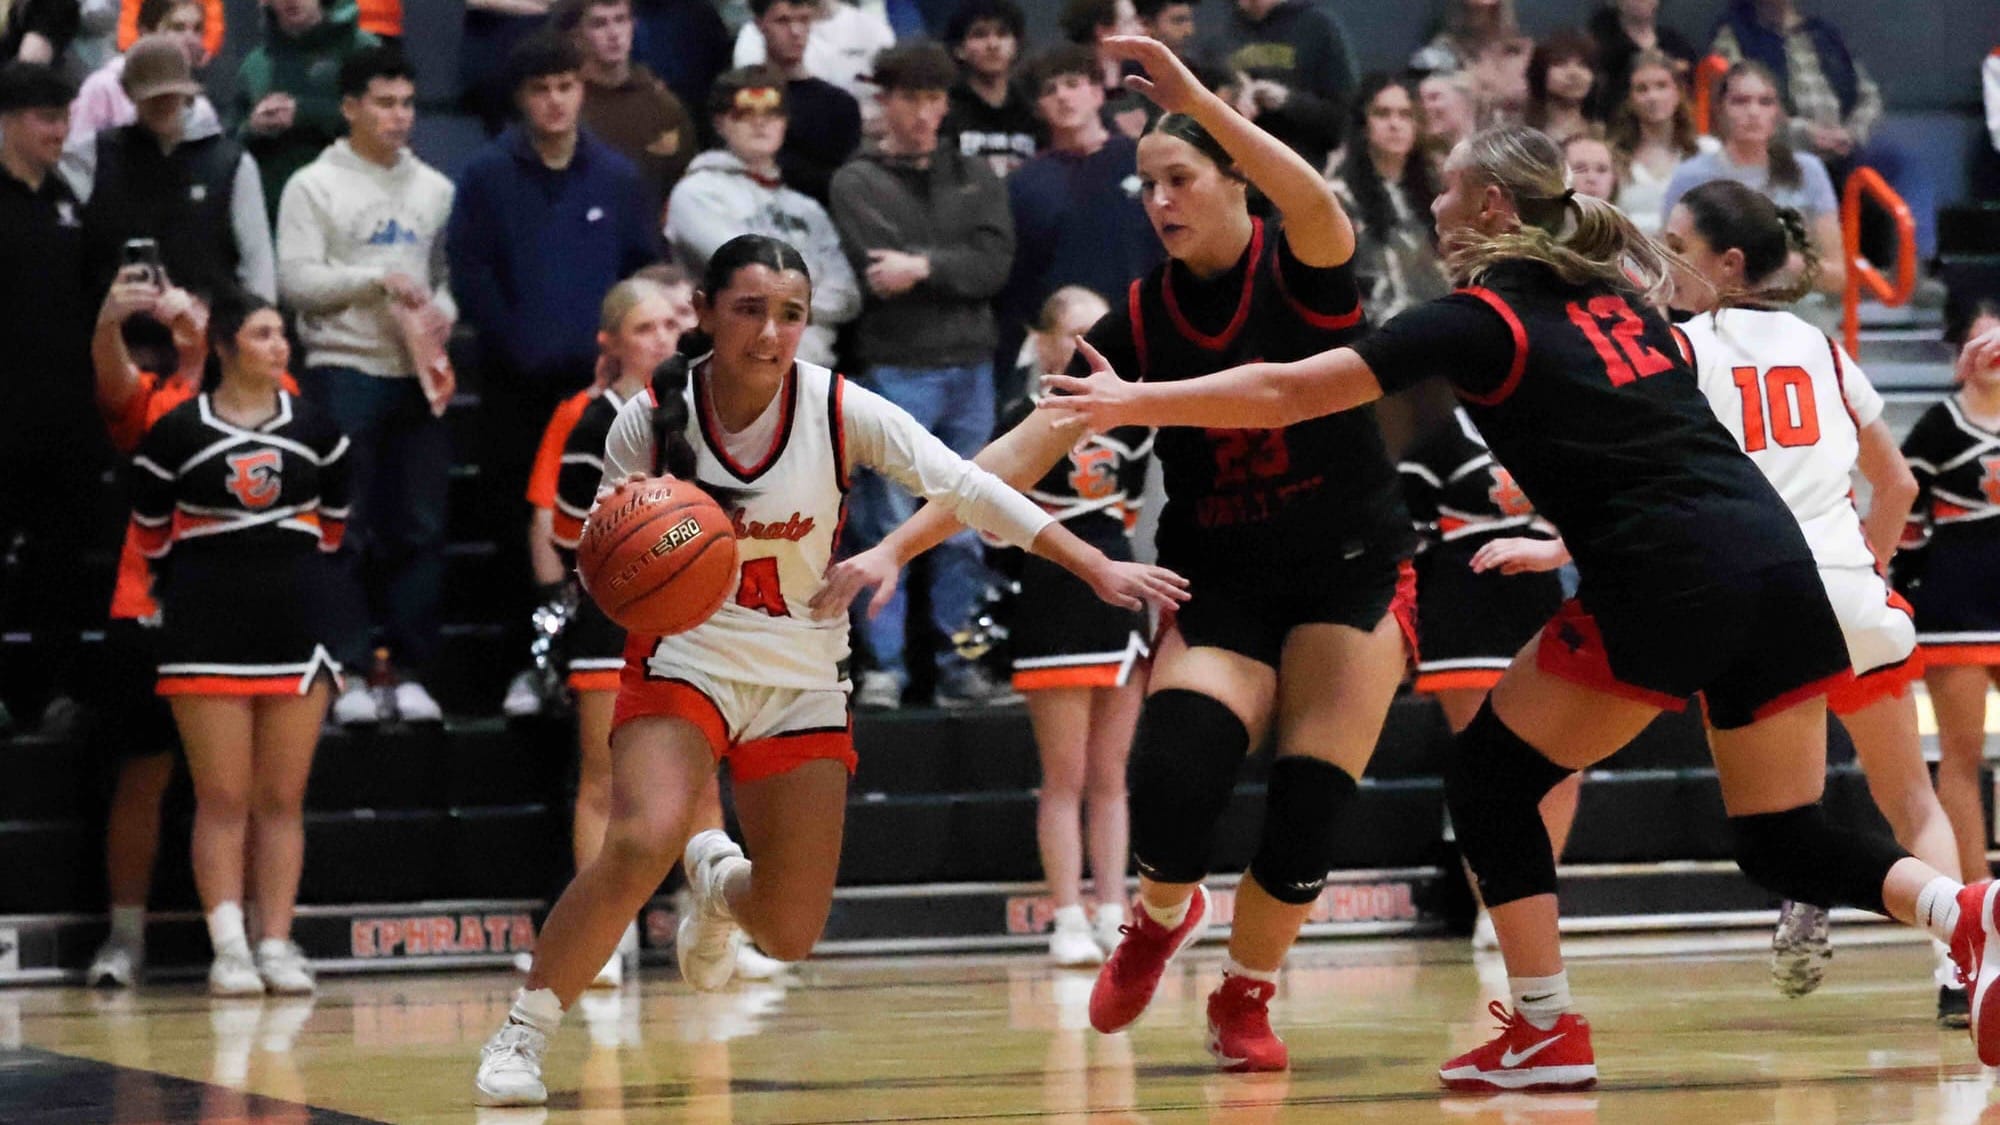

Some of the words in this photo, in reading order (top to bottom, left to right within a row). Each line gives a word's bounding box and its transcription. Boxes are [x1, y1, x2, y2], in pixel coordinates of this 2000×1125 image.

[1565, 295, 1675, 388] 12
[1732, 365, 1821, 453] 10
[225, 447, 283, 509] E
[668, 518, 701, 547] PRO
[1308, 882, 1418, 922] CHOOL
[351, 914, 537, 959] EPHRATA
